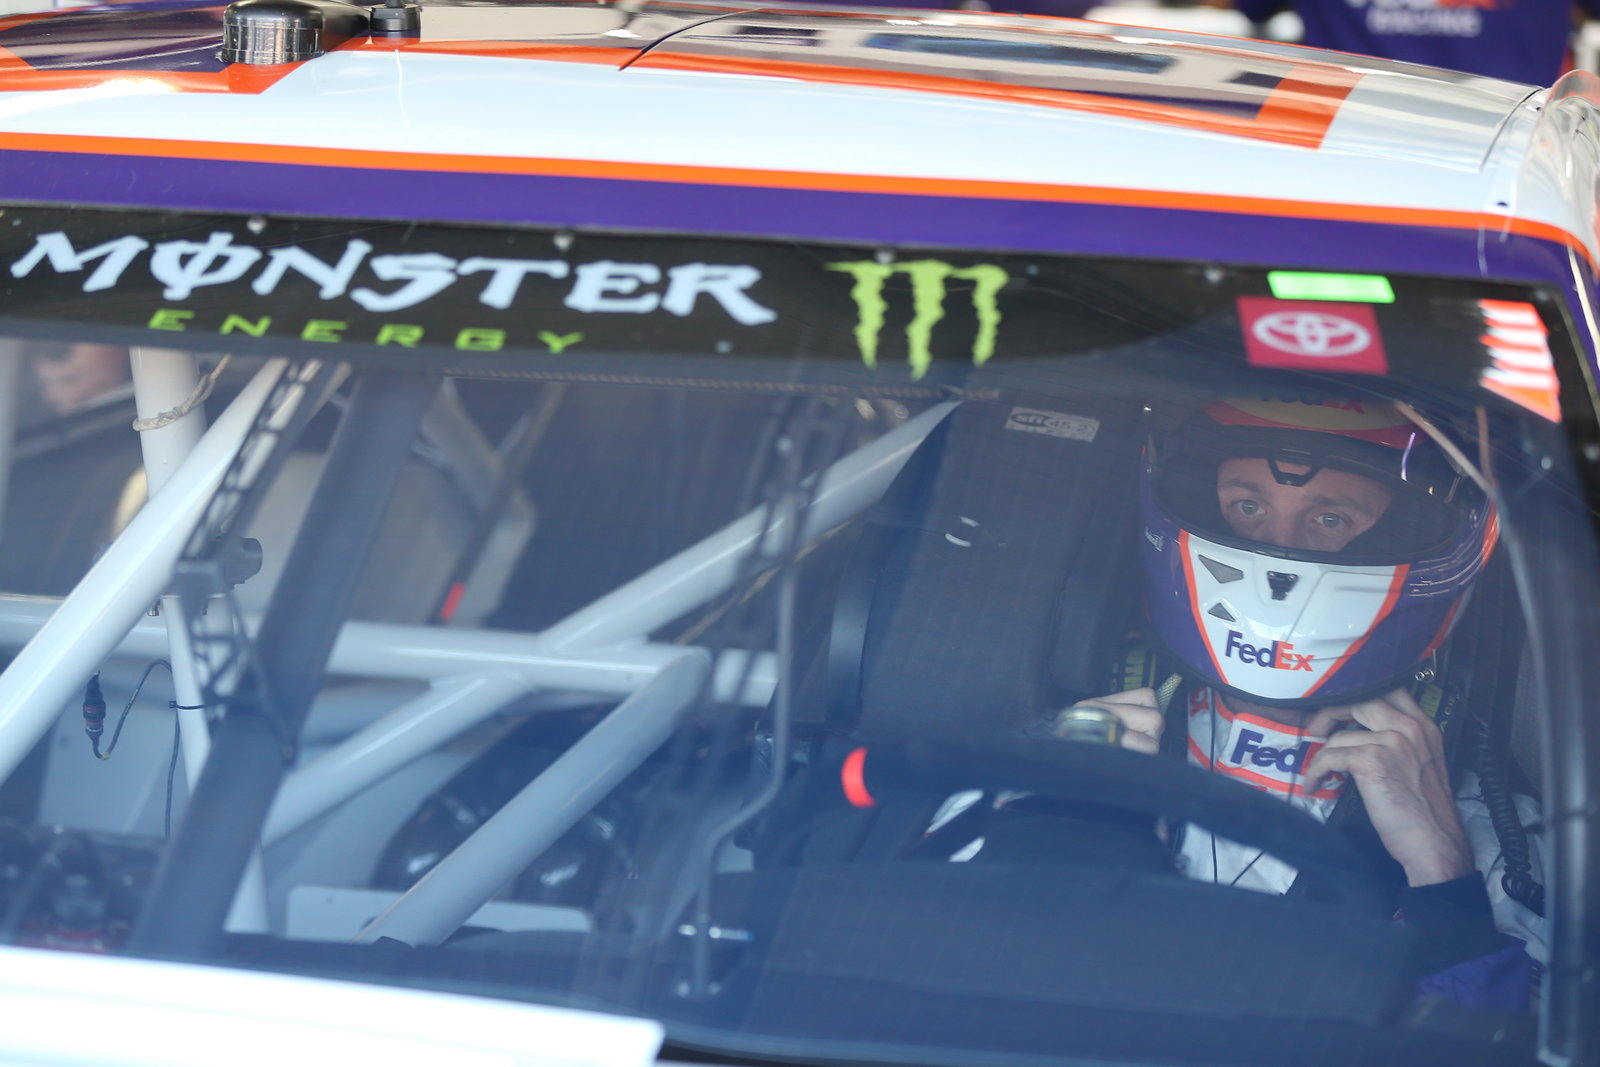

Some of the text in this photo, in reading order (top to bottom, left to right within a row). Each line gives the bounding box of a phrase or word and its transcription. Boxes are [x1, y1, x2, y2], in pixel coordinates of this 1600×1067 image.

[1366, 8, 1481, 37] RACING
[148, 308, 585, 354] ENERGY
[1226, 629, 1316, 672] FedEx
